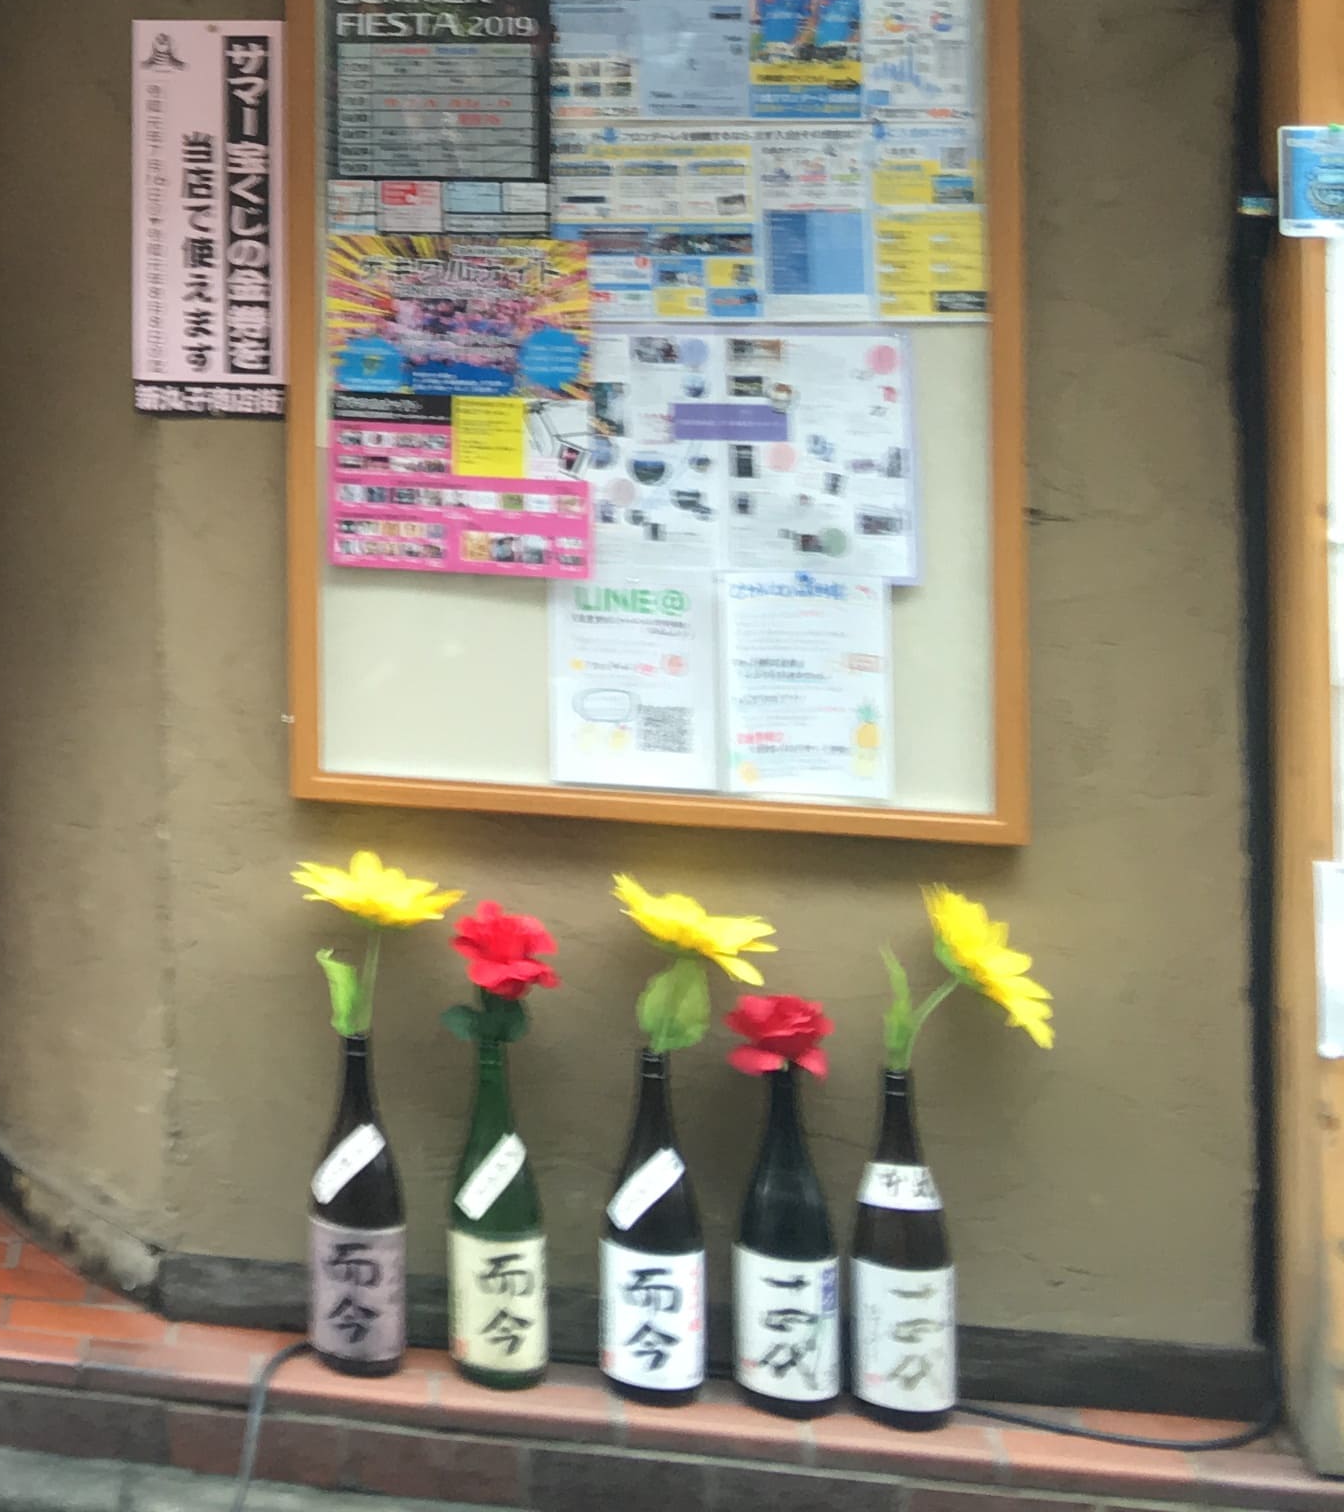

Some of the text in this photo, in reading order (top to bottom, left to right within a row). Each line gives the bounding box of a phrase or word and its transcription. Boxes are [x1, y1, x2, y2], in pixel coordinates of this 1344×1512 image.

[336, 12, 540, 37] FIESTA 2019
[323, 1241, 386, 1345] 而今
[475, 1252, 538, 1356] 而今
[623, 1267, 685, 1371] 而今
